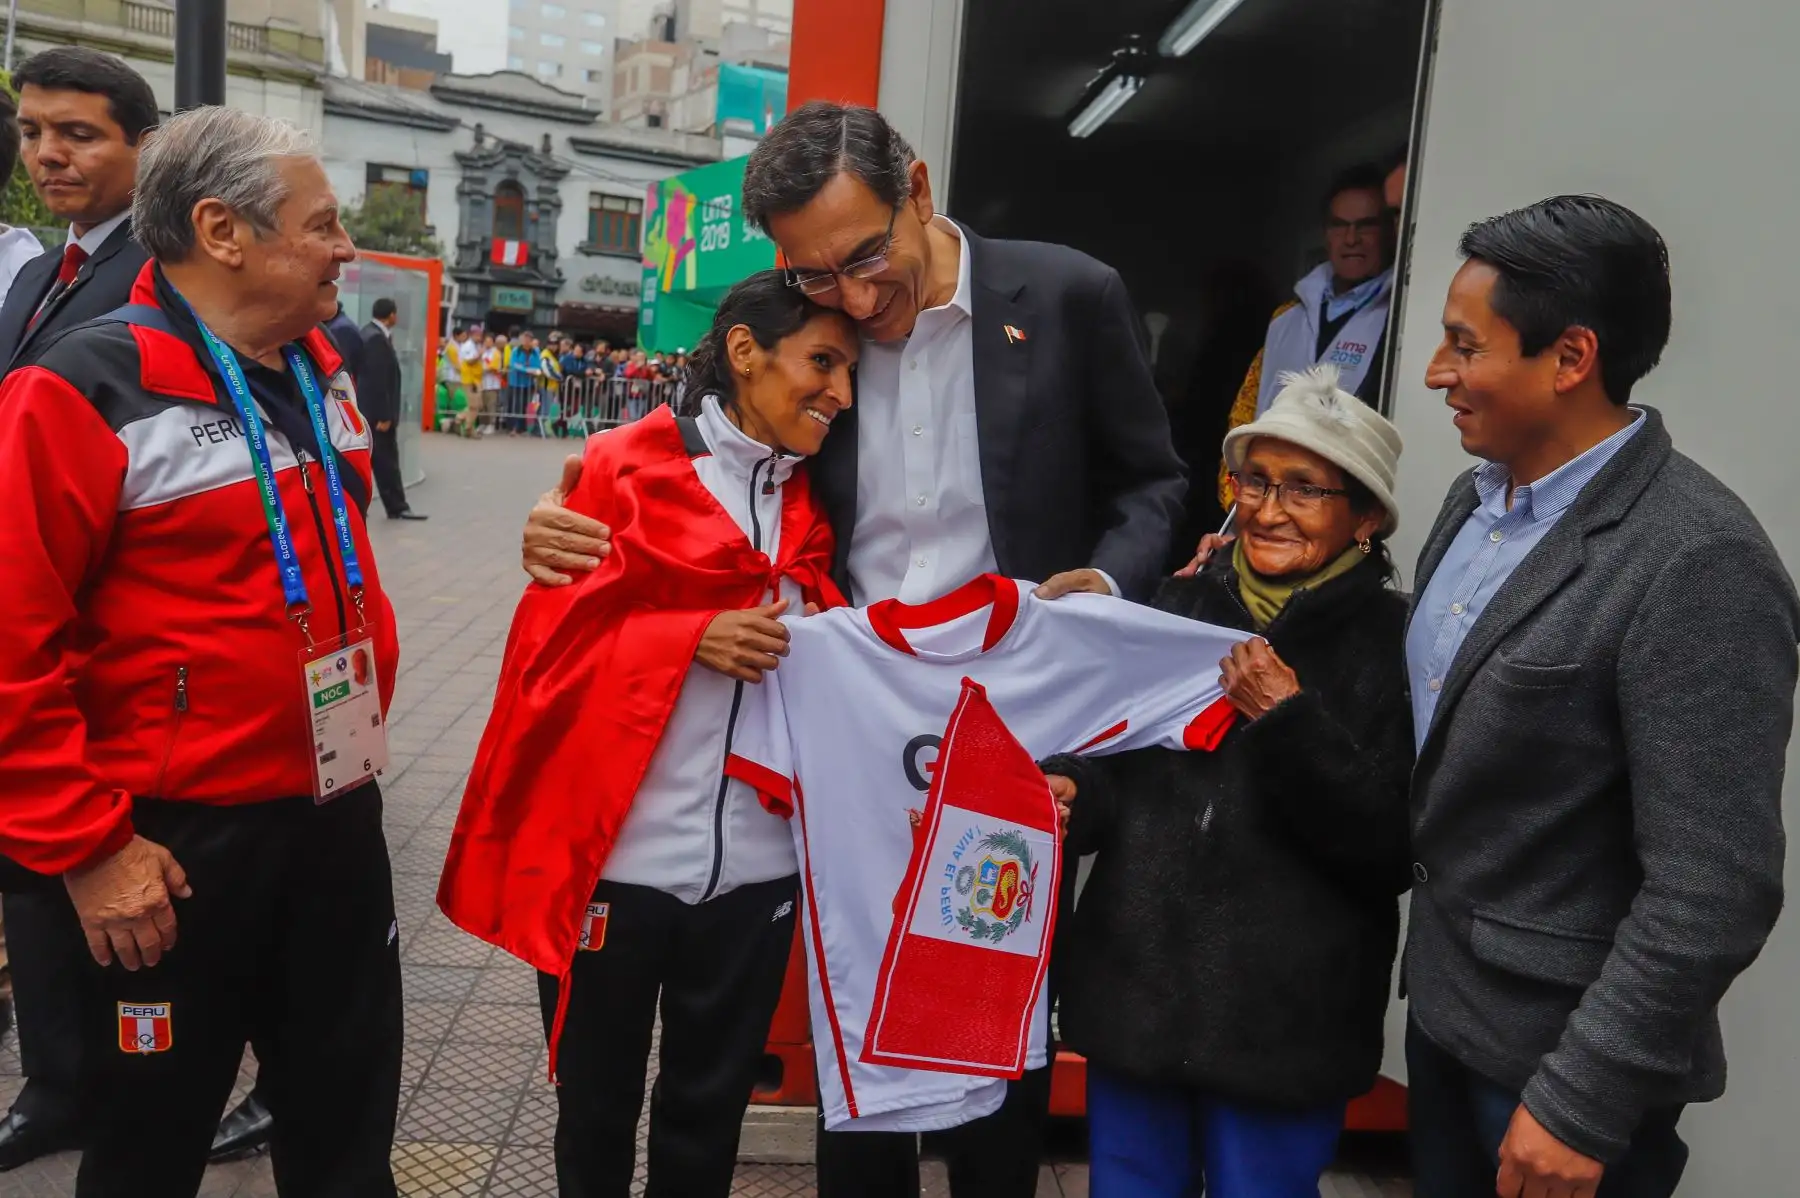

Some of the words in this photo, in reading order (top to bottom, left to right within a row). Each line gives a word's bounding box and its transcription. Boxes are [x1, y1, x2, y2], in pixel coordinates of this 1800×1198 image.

[700, 221, 731, 253] 2019
[1336, 341, 1367, 354] Lima
[1330, 350, 1363, 365] 2019
[243, 407, 263, 450] Lima2019
[260, 462, 276, 506] Lima2019
[273, 517, 290, 560] Lima2019
[320, 685, 344, 703] NOC
[363, 758, 371, 771] 6
[122, 1006, 166, 1017] PERU
